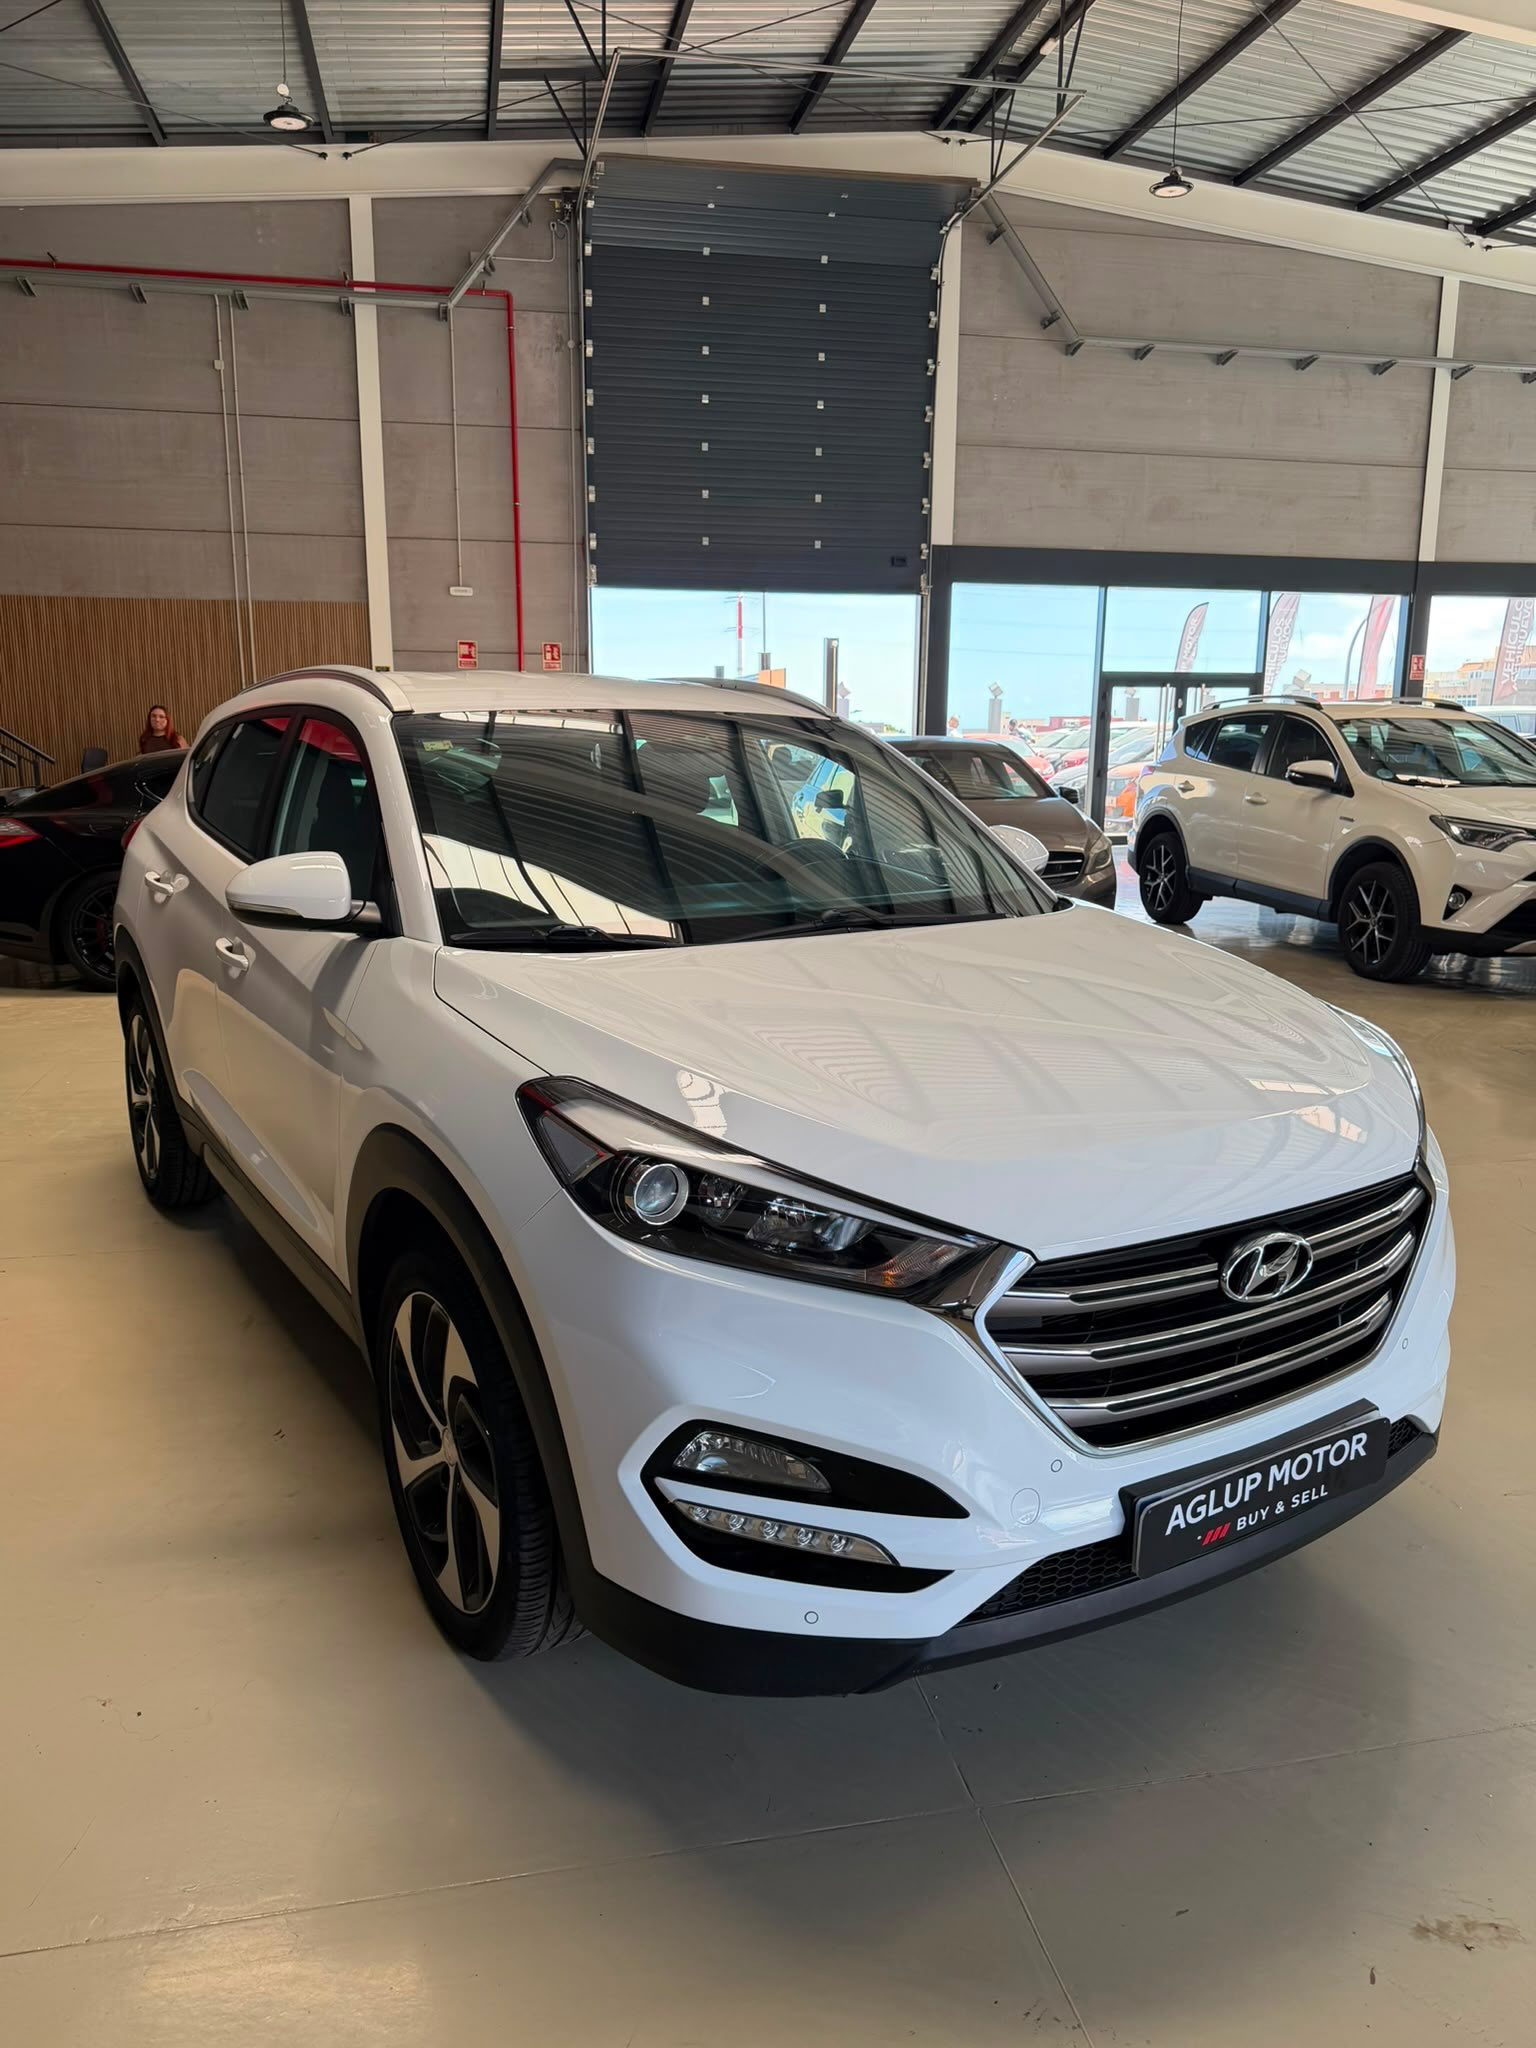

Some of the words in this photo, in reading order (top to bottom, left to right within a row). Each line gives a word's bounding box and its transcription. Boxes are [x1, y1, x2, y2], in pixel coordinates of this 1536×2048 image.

[1501, 599, 1523, 684] VEHÍCULO
[1165, 1472, 1262, 1535] AGLUP
[1268, 1432, 1368, 1492] MOTOR
[1236, 1506, 1270, 1531] BUY
[1274, 1500, 1285, 1515] &
[1291, 1484, 1328, 1508] SELL
